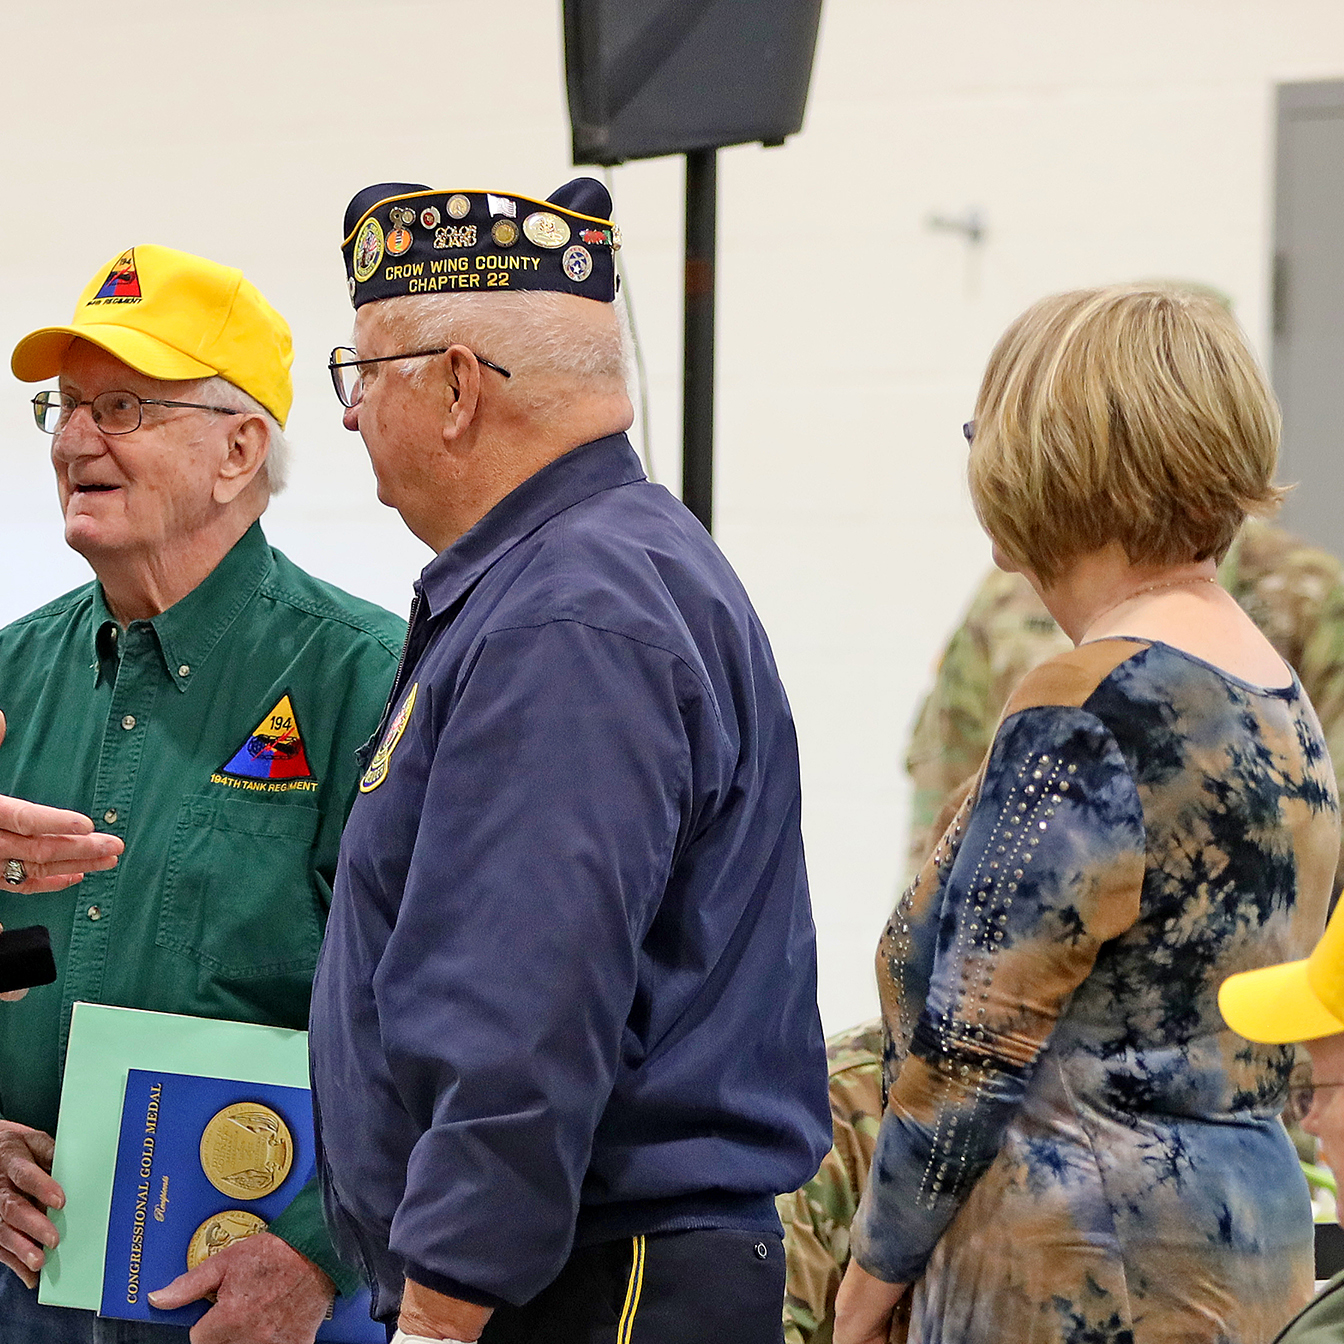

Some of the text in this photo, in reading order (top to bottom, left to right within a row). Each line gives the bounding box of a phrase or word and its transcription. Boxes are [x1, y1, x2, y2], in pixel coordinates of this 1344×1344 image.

[435, 225, 478, 239] COLOR
[433, 236, 478, 250] GUARD
[385, 254, 541, 281] CROW WING COUNTY
[408, 272, 510, 293] CHAPTER 22
[269, 715, 293, 731] 194
[210, 774, 241, 788] 194TH
[242, 780, 267, 792] TANK
[126, 1082, 163, 1305] CONGRESSIONAL GOLD MEDAL
